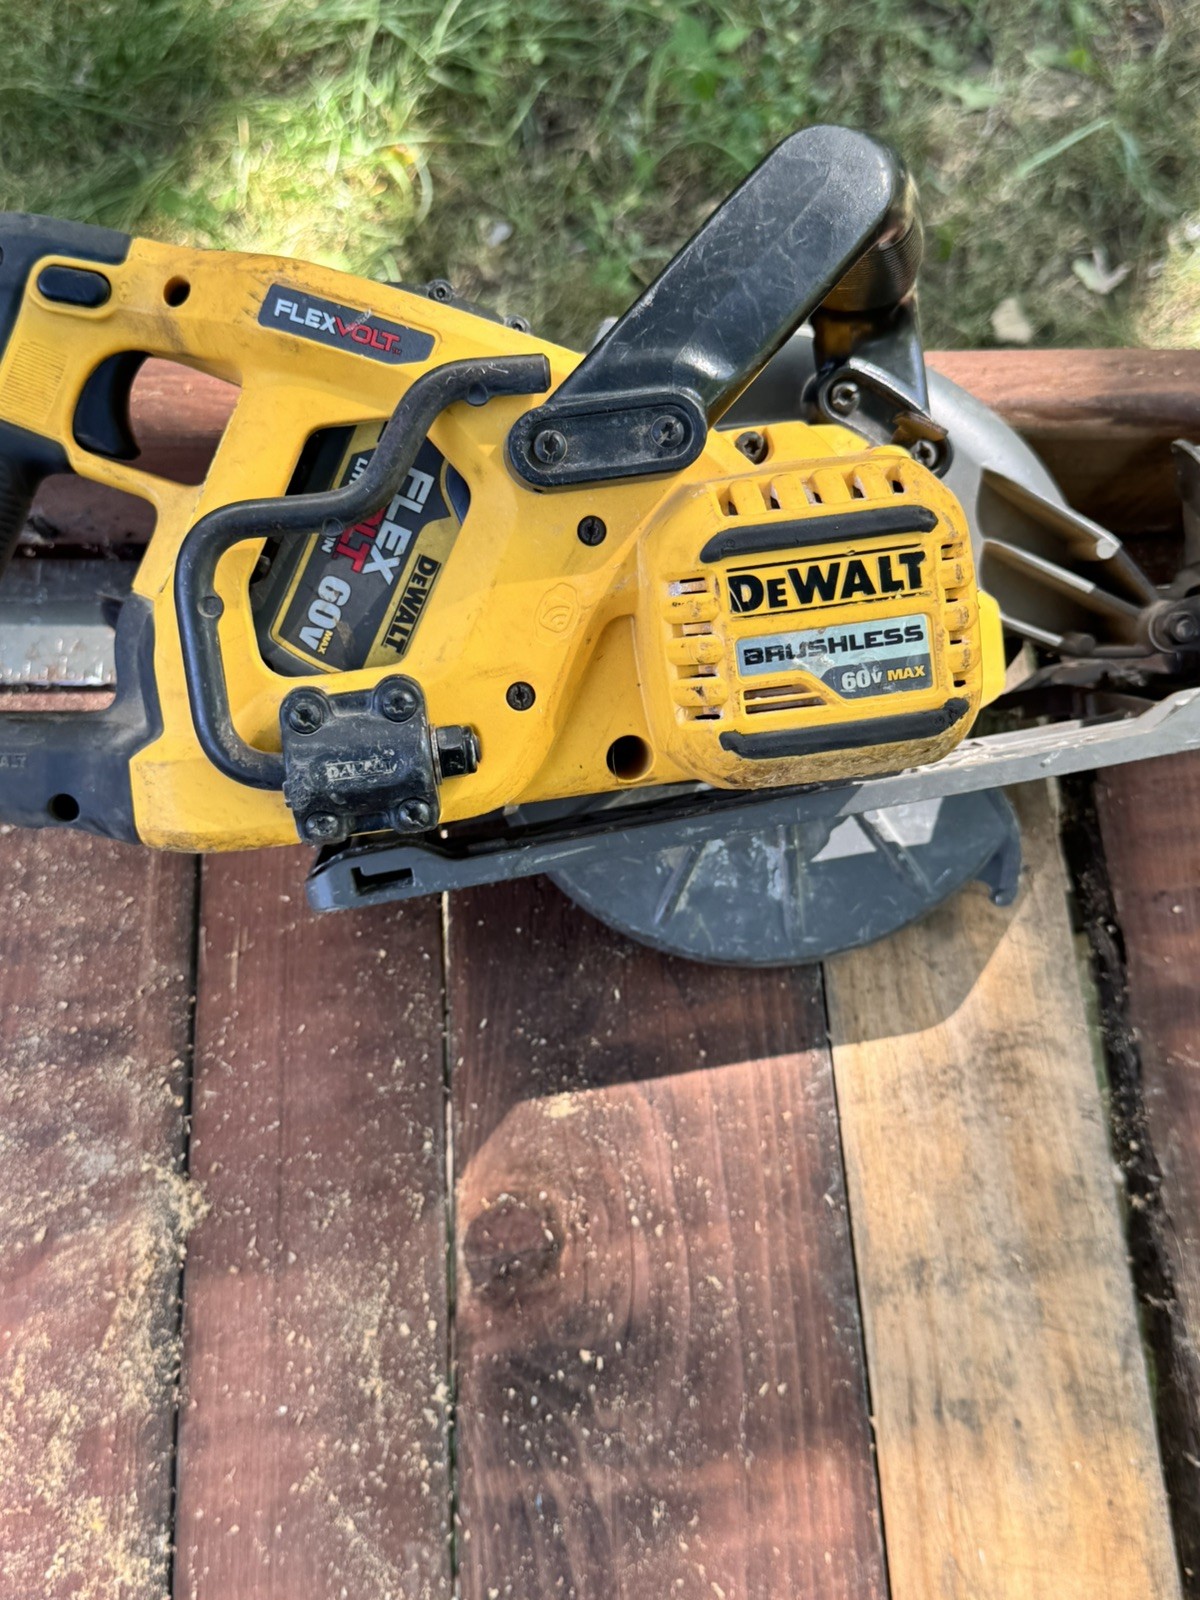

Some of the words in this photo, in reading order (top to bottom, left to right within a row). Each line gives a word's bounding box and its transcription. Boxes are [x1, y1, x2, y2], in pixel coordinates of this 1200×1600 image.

[274, 299, 400, 351] FLEXVOLT
[362, 467, 435, 585] FLEX
[385, 556, 440, 653] DEWALT
[727, 551, 926, 613] DEWALT
[299, 575, 351, 650] 60V
[317, 629, 333, 655] MAX
[743, 625, 924, 666] BRUSHLESS
[887, 665, 925, 681] MAX
